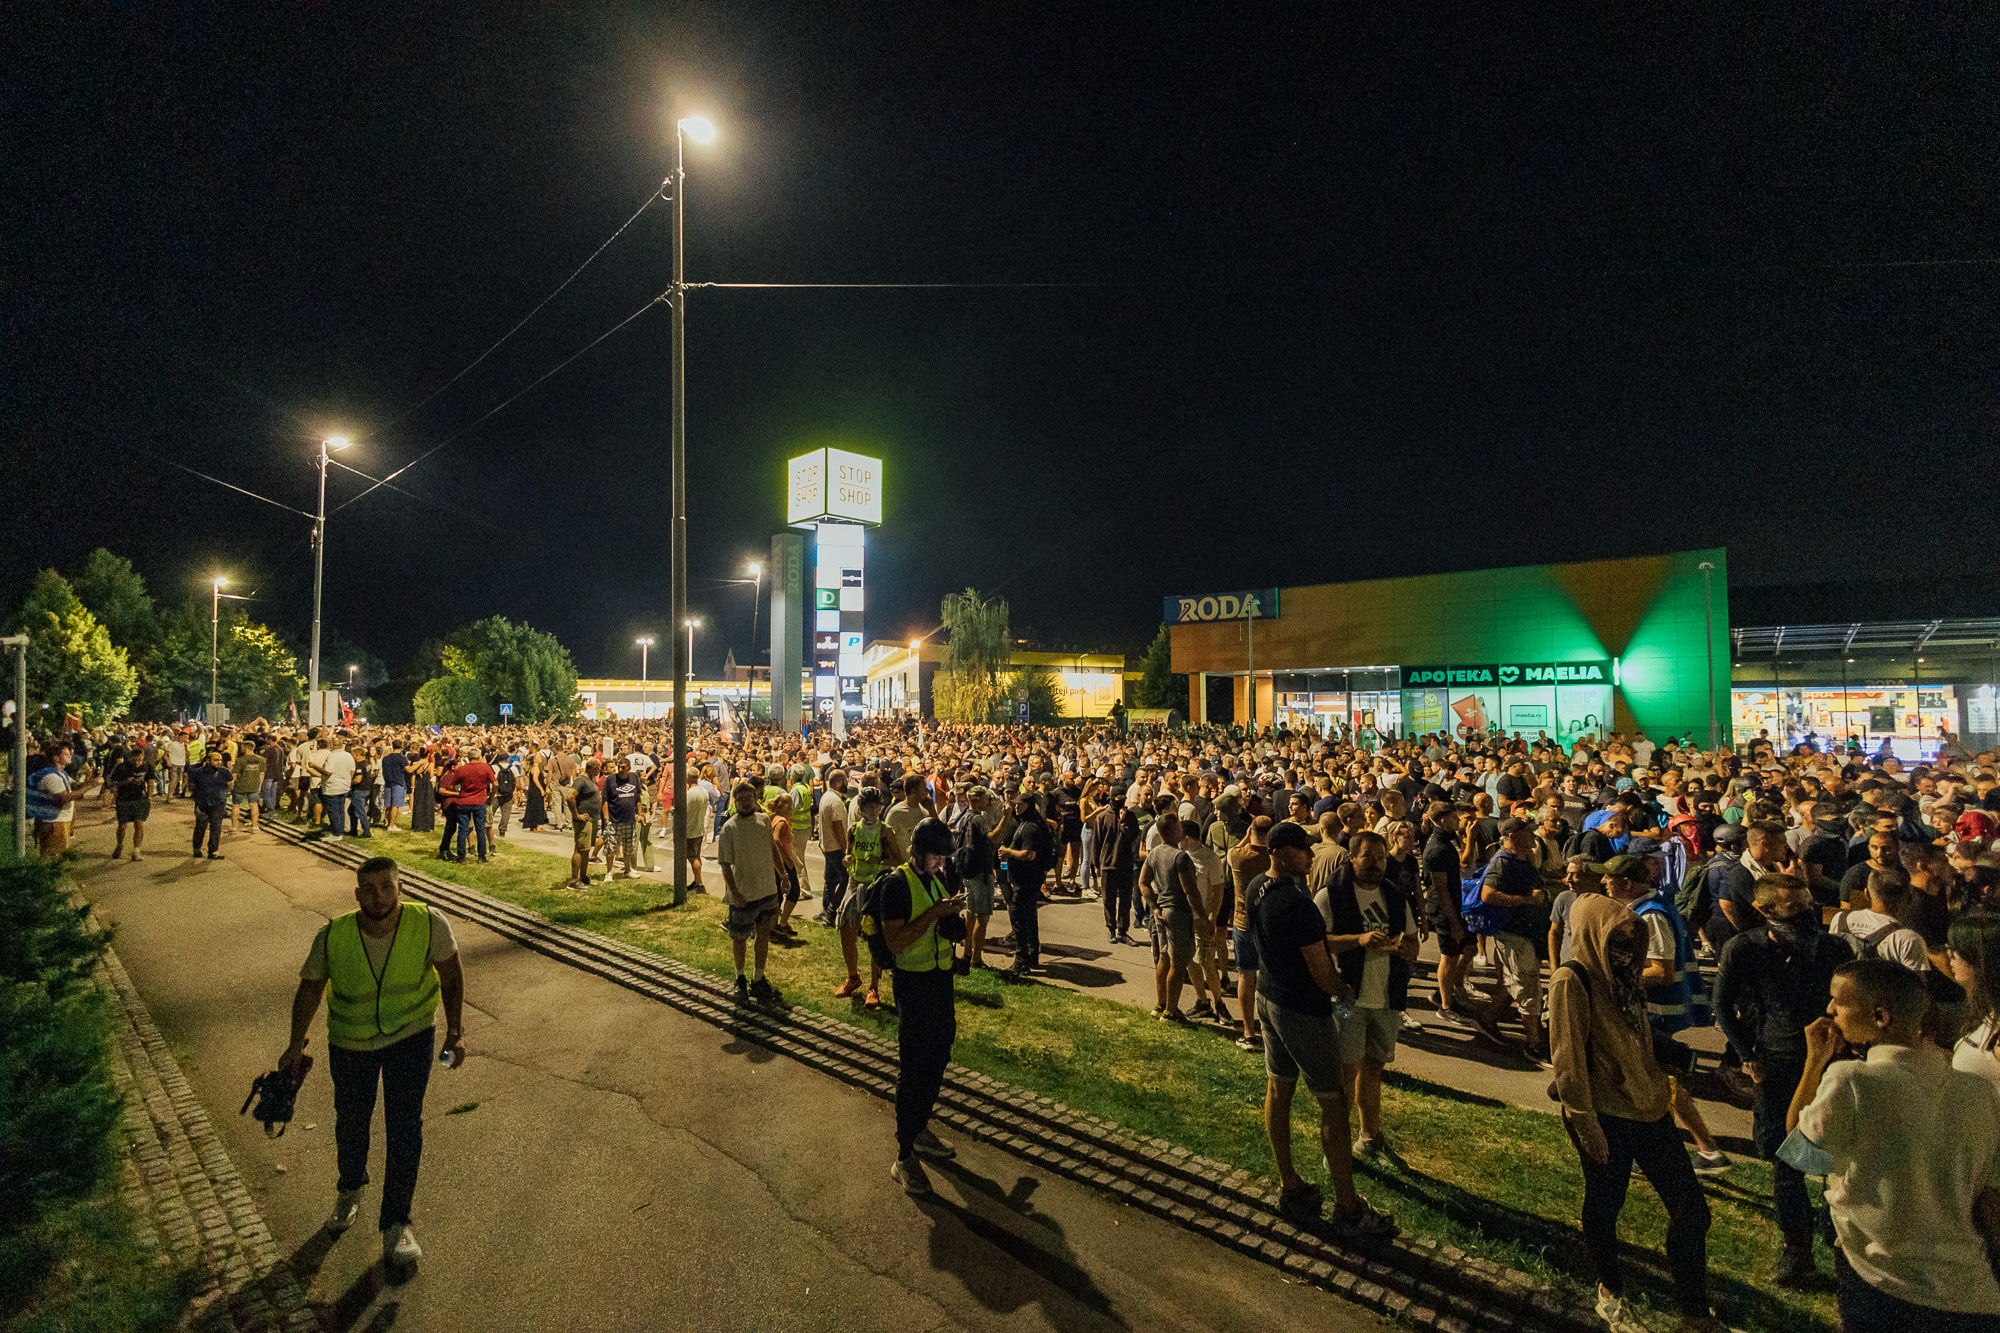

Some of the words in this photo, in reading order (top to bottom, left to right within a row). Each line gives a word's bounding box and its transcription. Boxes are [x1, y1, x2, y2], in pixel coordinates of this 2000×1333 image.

[796, 465, 818, 486] STOP
[839, 465, 872, 484] STOP
[796, 488, 818, 507] SHOP
[839, 488, 872, 506] SHOP
[788, 544, 800, 593] RODA
[822, 591, 835, 604] D
[1178, 593, 1262, 622] RODA
[1409, 669, 1493, 683] APOTEKA
[1525, 665, 1603, 681] MAELIA
[1020, 703, 1026, 714] P
